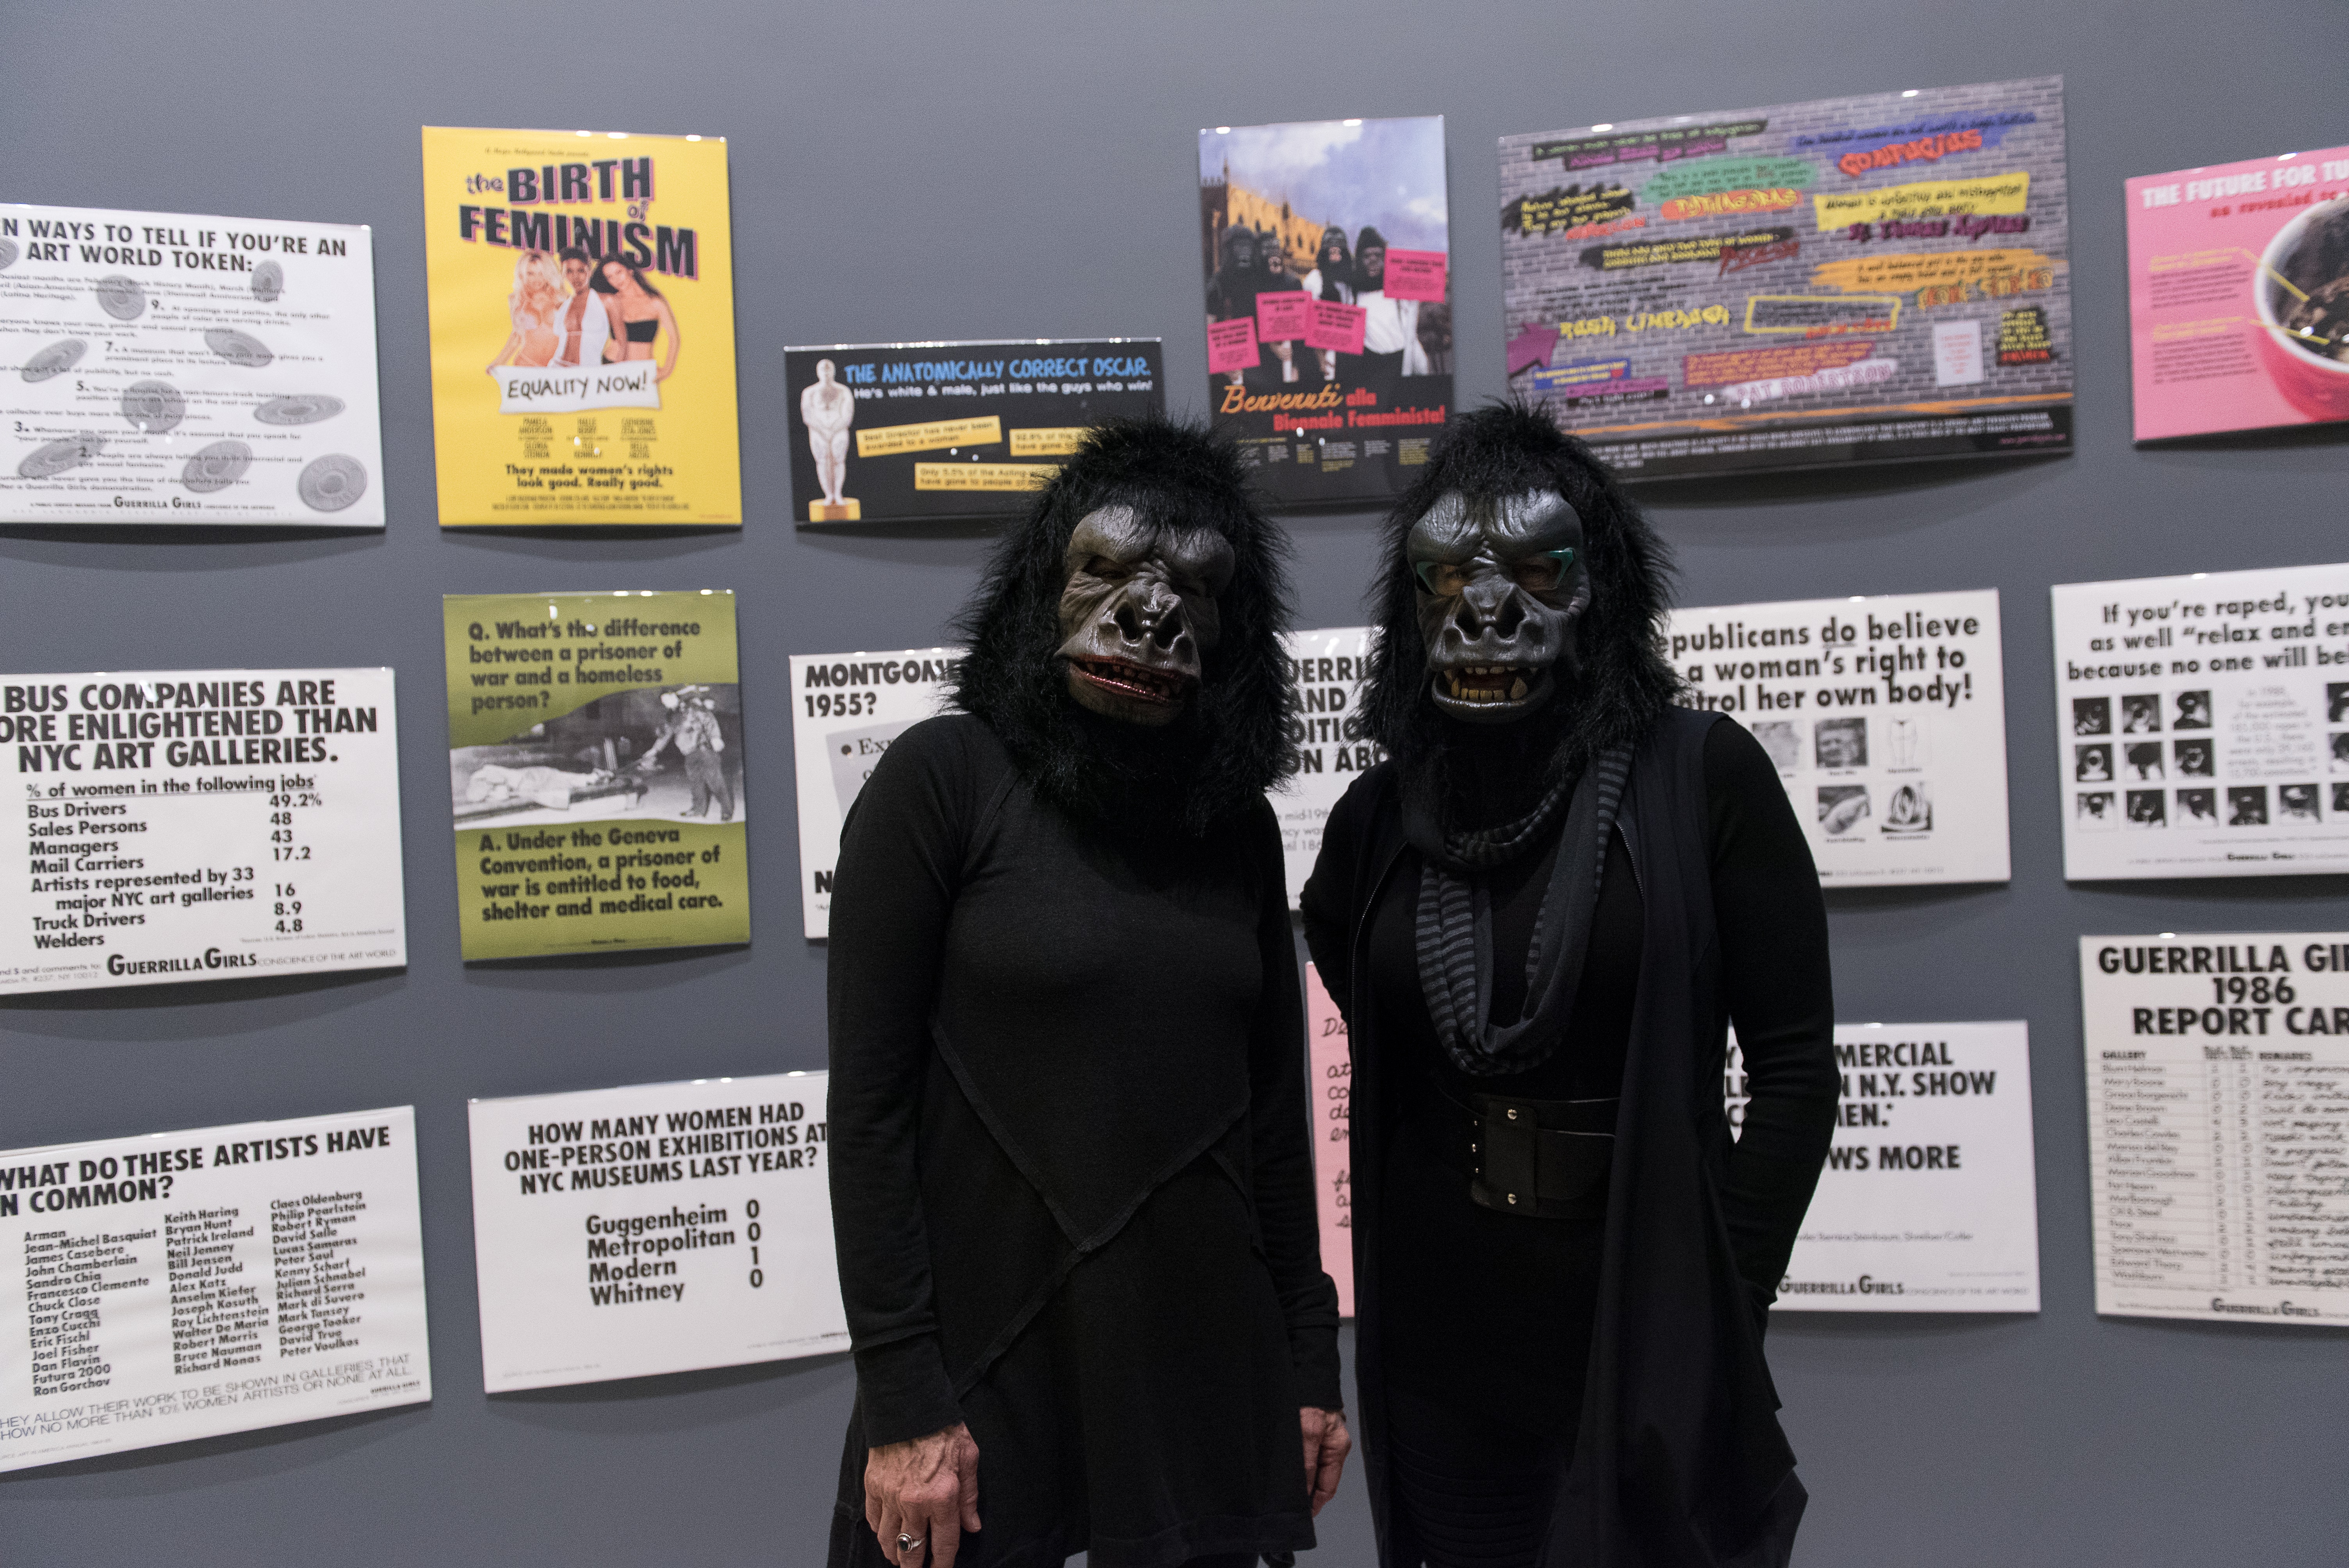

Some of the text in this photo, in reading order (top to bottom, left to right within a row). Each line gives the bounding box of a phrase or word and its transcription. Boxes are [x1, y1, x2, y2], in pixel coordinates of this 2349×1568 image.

[465, 157, 654, 205] the BIRTH
[2142, 164, 2316, 207] THE FUTURE FOR
[627, 199, 649, 221] of
[29, 220, 346, 256] WAYS TO TELL IF YOU'RE AN
[459, 205, 698, 280] FEMINISM
[27, 242, 252, 272] ART WORLD TOKEN:
[151, 299, 164, 311] 9.
[845, 357, 1150, 383] THE ANATOMICALLY CORRECT OSCAR.
[507, 371, 647, 398] EQUALITY NOW!
[1220, 384, 1376, 413] Benvenuti alla
[1274, 406, 1445, 431] Biennale Femminista!
[506, 463, 673, 478] They made women's rights
[518, 476, 661, 491] look good. Really good.
[114, 496, 201, 508] GUERRILLA GIRLS
[2103, 592, 2295, 625] If you're raped,
[469, 619, 700, 641] Q. What's the difference
[1821, 612, 1980, 649] do believe
[2091, 621, 2315, 651] as well "relax and
[1686, 646, 1965, 683] a woman's right to
[2067, 648, 2306, 680] because no one will
[5, 680, 335, 713] BUS COMPANIES ARE
[806, 692, 876, 717] 1955?
[1757, 673, 1971, 710] her own body!
[69, 707, 377, 740] ENLIGHTENED THAN
[19, 737, 338, 772] NYC ART GALLERIES.
[28, 793, 321, 818] Bus Drivers 49.2%
[29, 812, 292, 837] Sales Persons 48
[30, 830, 292, 857] Managers 43
[483, 893, 723, 921] shelter and medical care.
[2098, 945, 2290, 974] GUERRILLA
[2213, 976, 2295, 1004] 1986
[2133, 1007, 2271, 1035] REPORT
[1859, 1071, 1995, 1097] N.Y. SHOW
[529, 1102, 804, 1145] HOW MANY WOMEN HAD
[80, 1157, 118, 1182] DO
[123, 1147, 203, 1176] THESE
[214, 1135, 318, 1166] ARTISTS
[327, 1126, 390, 1153] HAVE
[1880, 1146, 1959, 1169] MORE
[30, 1176, 173, 1213] COMMON?
[270, 1192, 362, 1210] Claes Oldenburg
[165, 1208, 239, 1224] Keith Haring
[586, 1206, 727, 1237] Guggenheim
[588, 1229, 735, 1258] Metropolitan
[169, 1262, 243, 1281] Donald Judd
[590, 1259, 676, 1283] Modern
[170, 1279, 226, 1293] Alex Katz
[590, 1284, 684, 1306] Whitney
[173, 1343, 262, 1363] Bruce Nauman
[280, 1339, 359, 1358] Peter Voulkos
